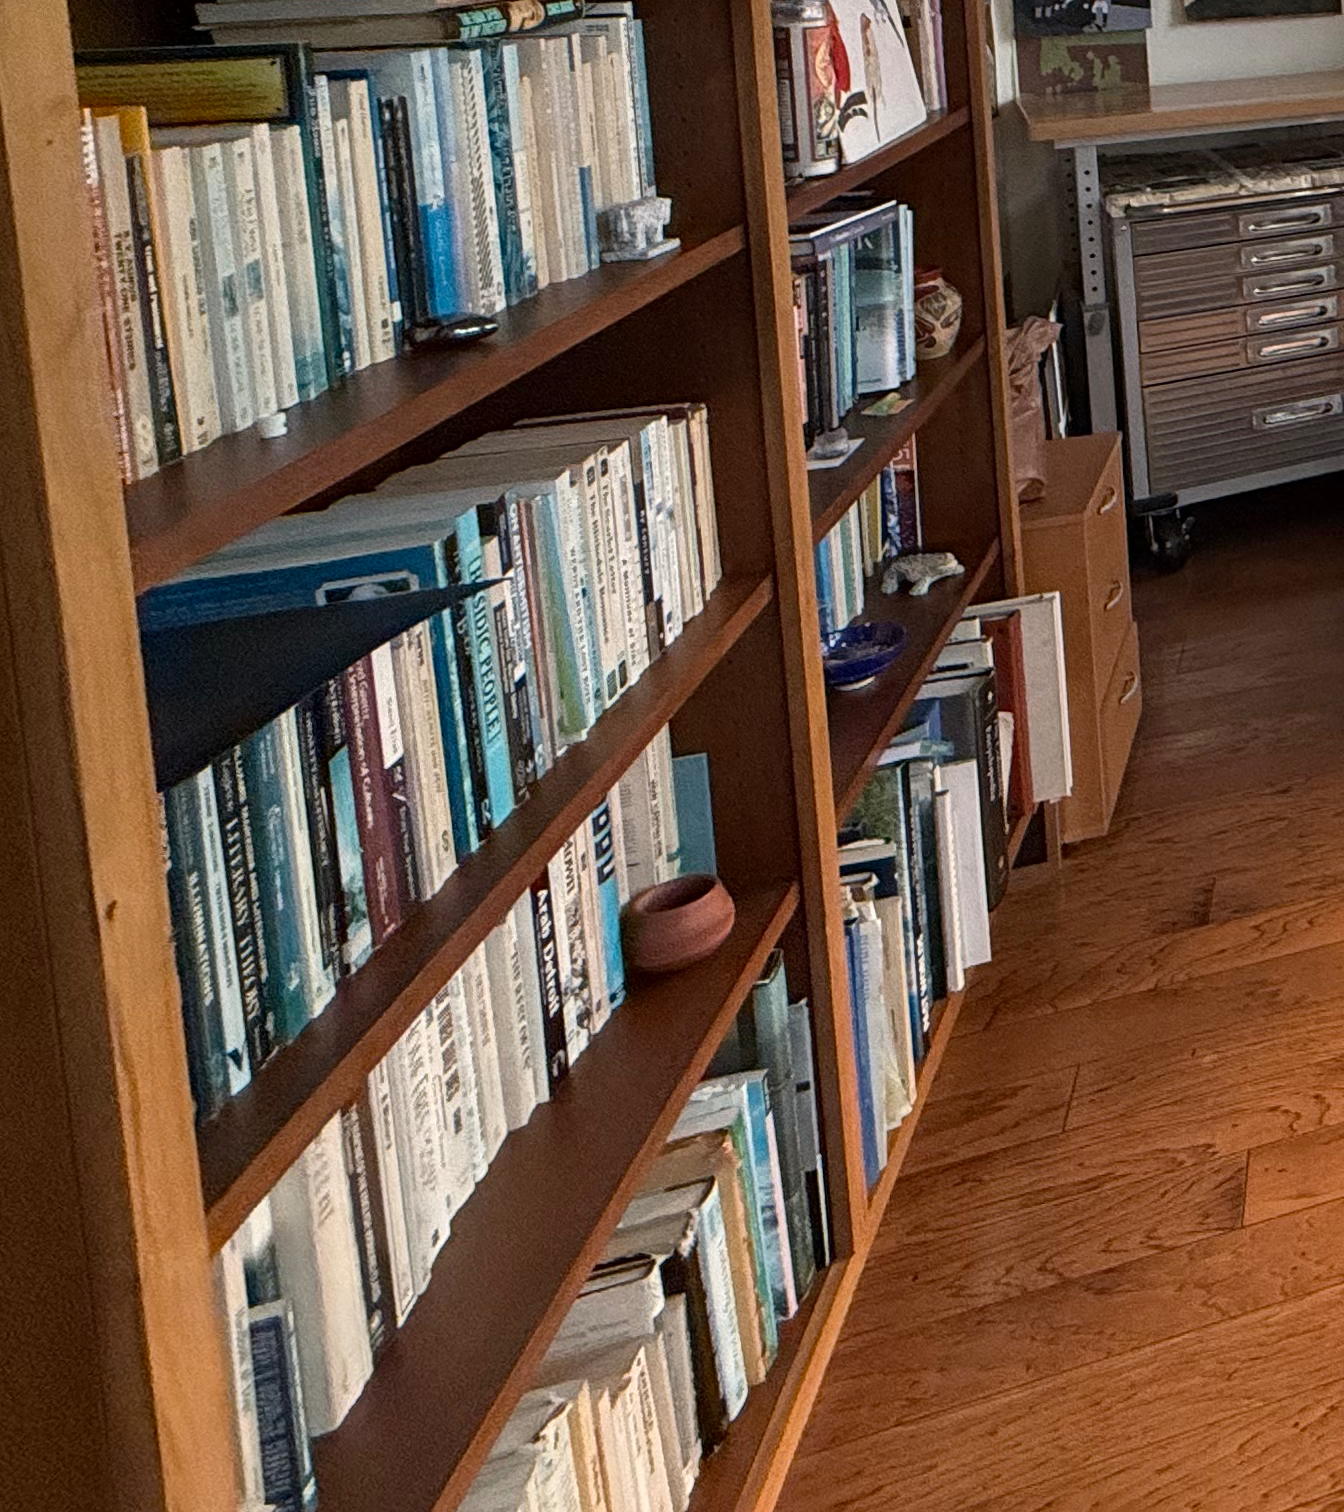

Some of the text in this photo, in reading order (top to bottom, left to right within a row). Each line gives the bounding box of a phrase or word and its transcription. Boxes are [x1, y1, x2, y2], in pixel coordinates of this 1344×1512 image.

[469, 567, 501, 733] HSIDIC PEOPLE
[512, 531, 532, 650] ANTISEMITISM
[224, 816, 251, 926] LITERARY
[187, 870, 214, 1006] ILLUMINATIONS
[237, 935, 260, 1022] THEORY
[536, 889, 561, 1018] Arab Detroit
